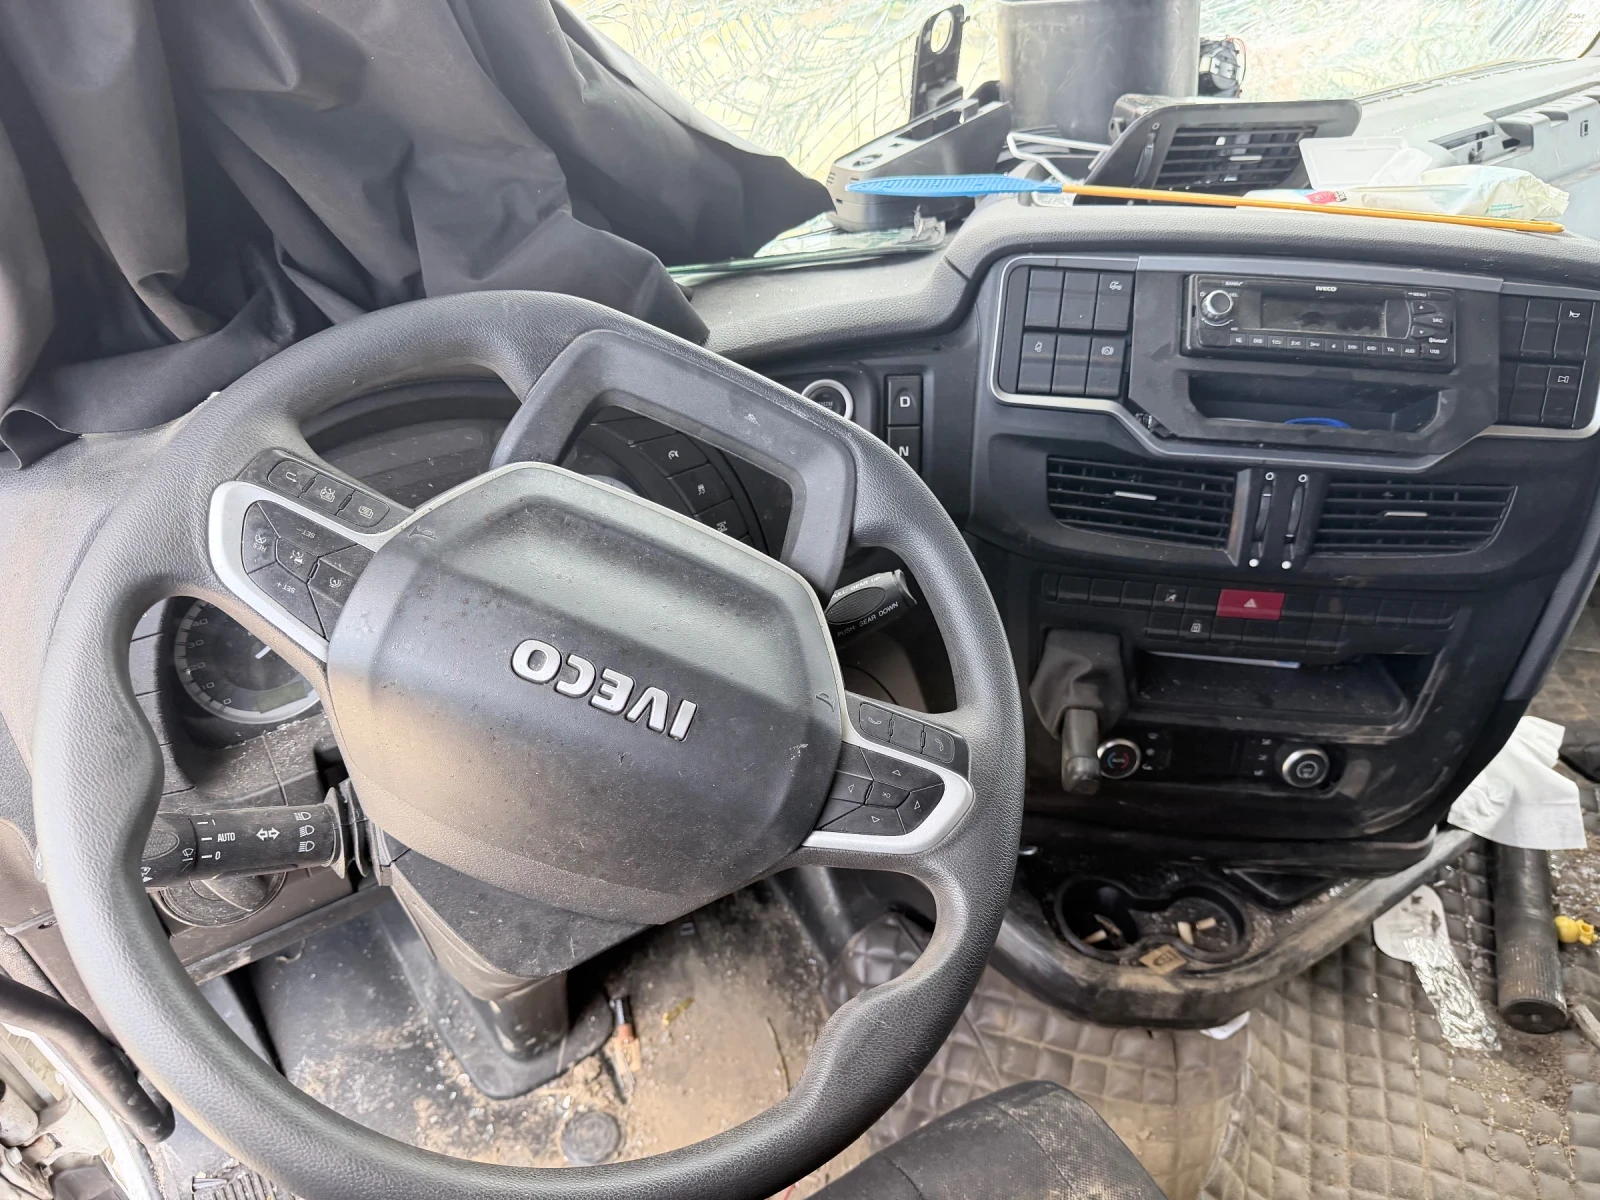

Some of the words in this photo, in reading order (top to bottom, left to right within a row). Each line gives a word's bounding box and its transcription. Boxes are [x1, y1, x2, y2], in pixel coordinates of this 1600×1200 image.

[899, 396, 911, 408] D
[899, 446, 910, 457] N
[301, 529, 316, 539] SET
[252, 541, 268, 553] RES
[282, 584, 296, 594] SET
[850, 580, 868, 591] GEAR
[859, 614, 877, 627] GEAR
[878, 601, 899, 617] DOWN
[192, 618, 209, 627] 40
[187, 639, 204, 649] 30
[189, 661, 206, 671] 20
[202, 681, 215, 690] 10
[511, 638, 699, 742] IVECO
[223, 697, 232, 705] 0
[217, 832, 236, 843] AUTO
[214, 851, 221, 860] 0
